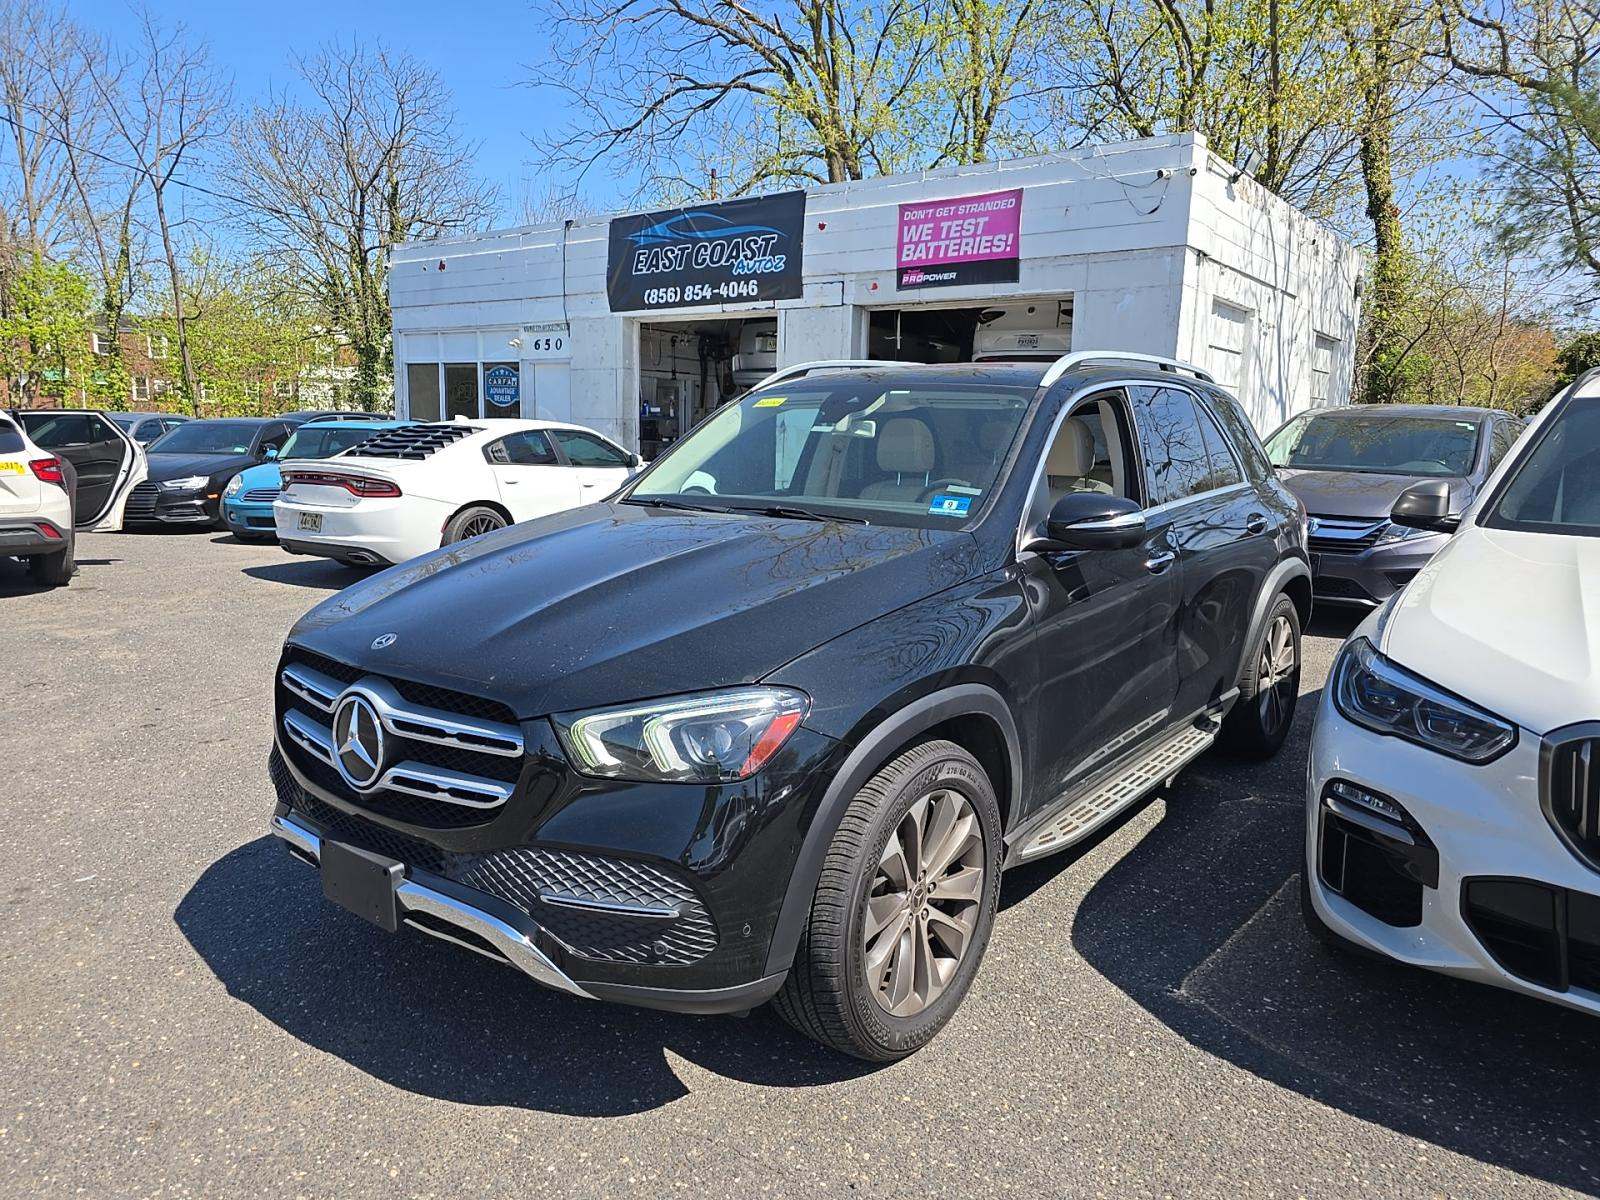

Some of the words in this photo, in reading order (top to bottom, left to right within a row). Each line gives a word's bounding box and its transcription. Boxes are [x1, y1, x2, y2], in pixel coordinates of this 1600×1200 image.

[903, 208, 934, 221] DON'T
[936, 206, 956, 217] GET
[958, 198, 1016, 215] STRANDED
[903, 223, 934, 243] WE
[940, 216, 989, 240] TEST
[632, 244, 692, 275] EAST
[693, 234, 777, 269] COAST
[901, 232, 1014, 262] BATTERIES!
[902, 272, 957, 285] PROPOWER
[644, 286, 681, 305] (856)
[684, 279, 759, 301] 854-4046
[534, 338, 563, 351] 650
[493, 394, 511, 402] DEALER
